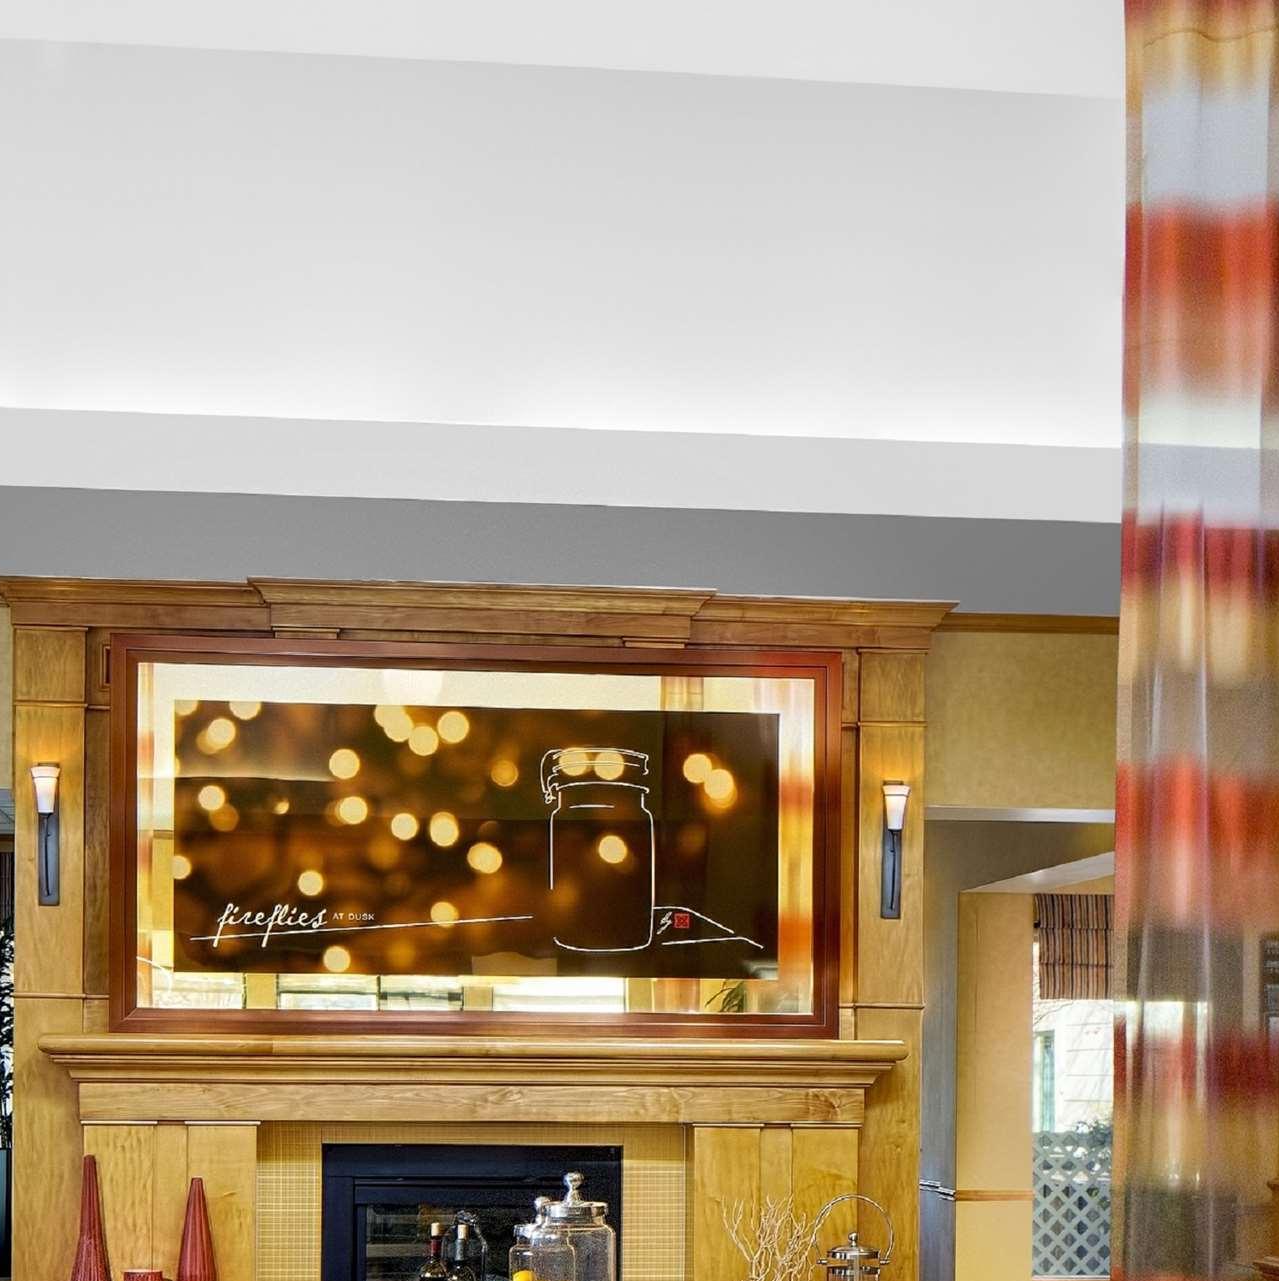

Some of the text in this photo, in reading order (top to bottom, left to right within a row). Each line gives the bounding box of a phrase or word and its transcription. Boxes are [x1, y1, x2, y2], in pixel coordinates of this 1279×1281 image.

[212, 903, 375, 947] fireflies AT DUSK
